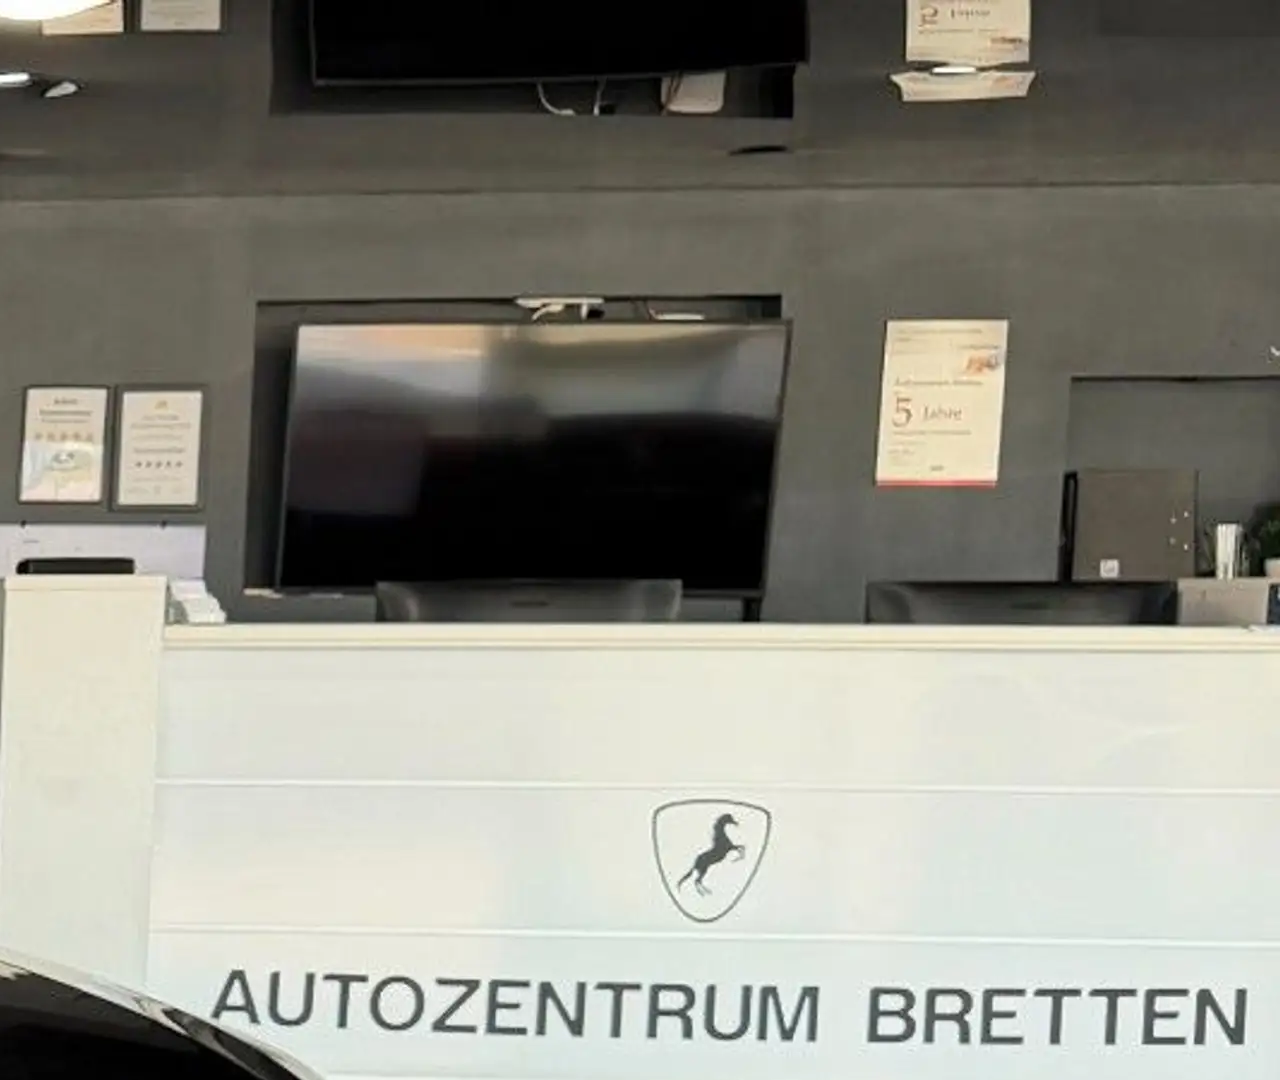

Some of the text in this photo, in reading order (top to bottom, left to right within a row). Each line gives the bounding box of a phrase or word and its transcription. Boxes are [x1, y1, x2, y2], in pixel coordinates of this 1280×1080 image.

[892, 397, 913, 428] 5
[211, 969, 1248, 1046] AUTOZENTRUM BRETTEN
